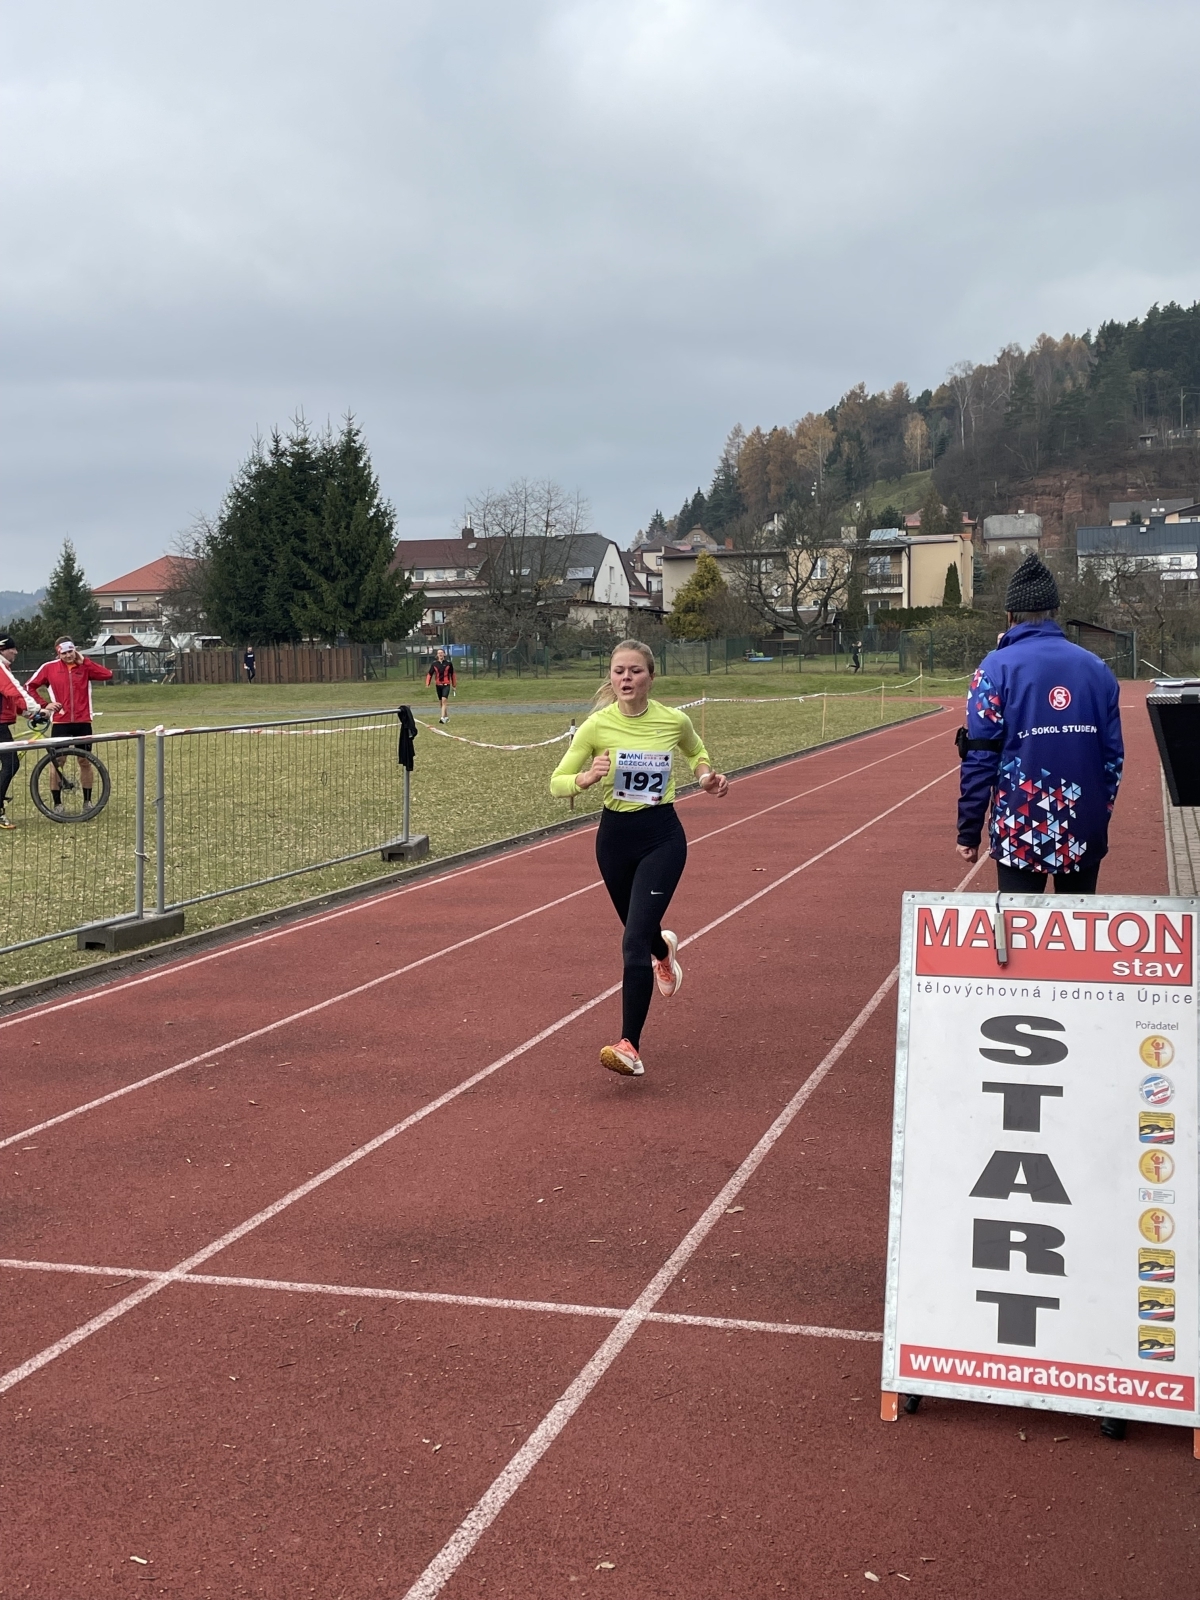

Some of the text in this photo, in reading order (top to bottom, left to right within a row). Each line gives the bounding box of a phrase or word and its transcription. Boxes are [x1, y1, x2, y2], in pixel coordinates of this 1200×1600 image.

[1031, 726, 1060, 735] SOKOL
[622, 771, 663, 793] 192
[917, 908, 1193, 955] MARATON
[1112, 957, 1184, 979] stav
[916, 982, 1193, 1005] tělovýchovná jednota Úpice
[1135, 1020, 1179, 1031] Pořadatel
[969, 1015, 1072, 1347] START
[909, 1353, 1185, 1402] www.maratonstav.cz
